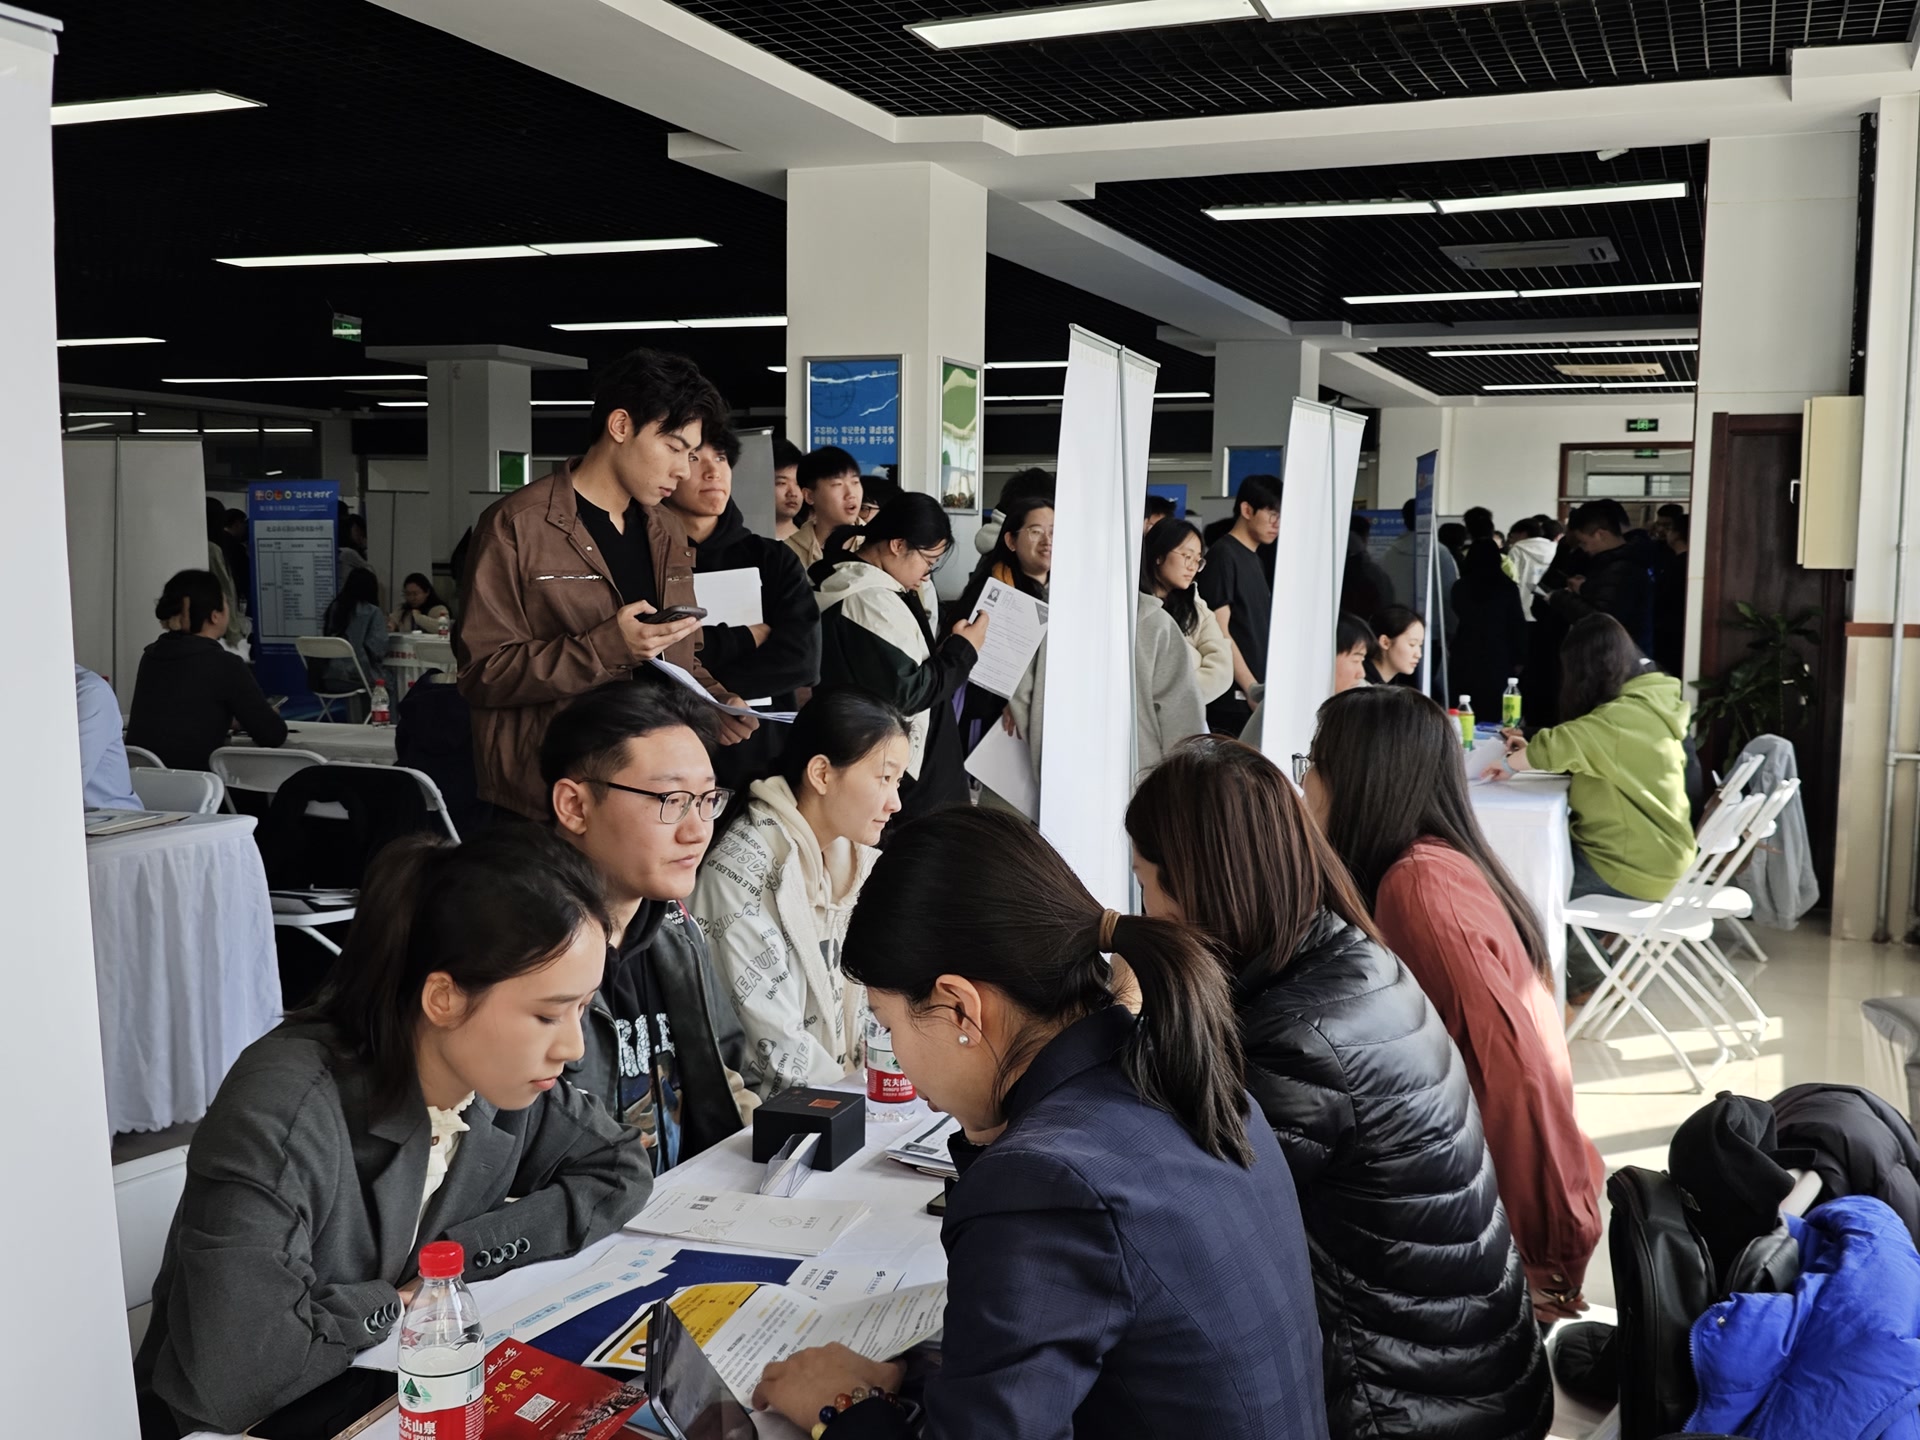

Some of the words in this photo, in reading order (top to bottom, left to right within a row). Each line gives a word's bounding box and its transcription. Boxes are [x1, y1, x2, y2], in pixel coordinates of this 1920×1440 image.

[814, 426, 838, 435] 不忘初心
[841, 426, 866, 435] 牢记使命
[841, 436, 866, 445] 敢于斗争
